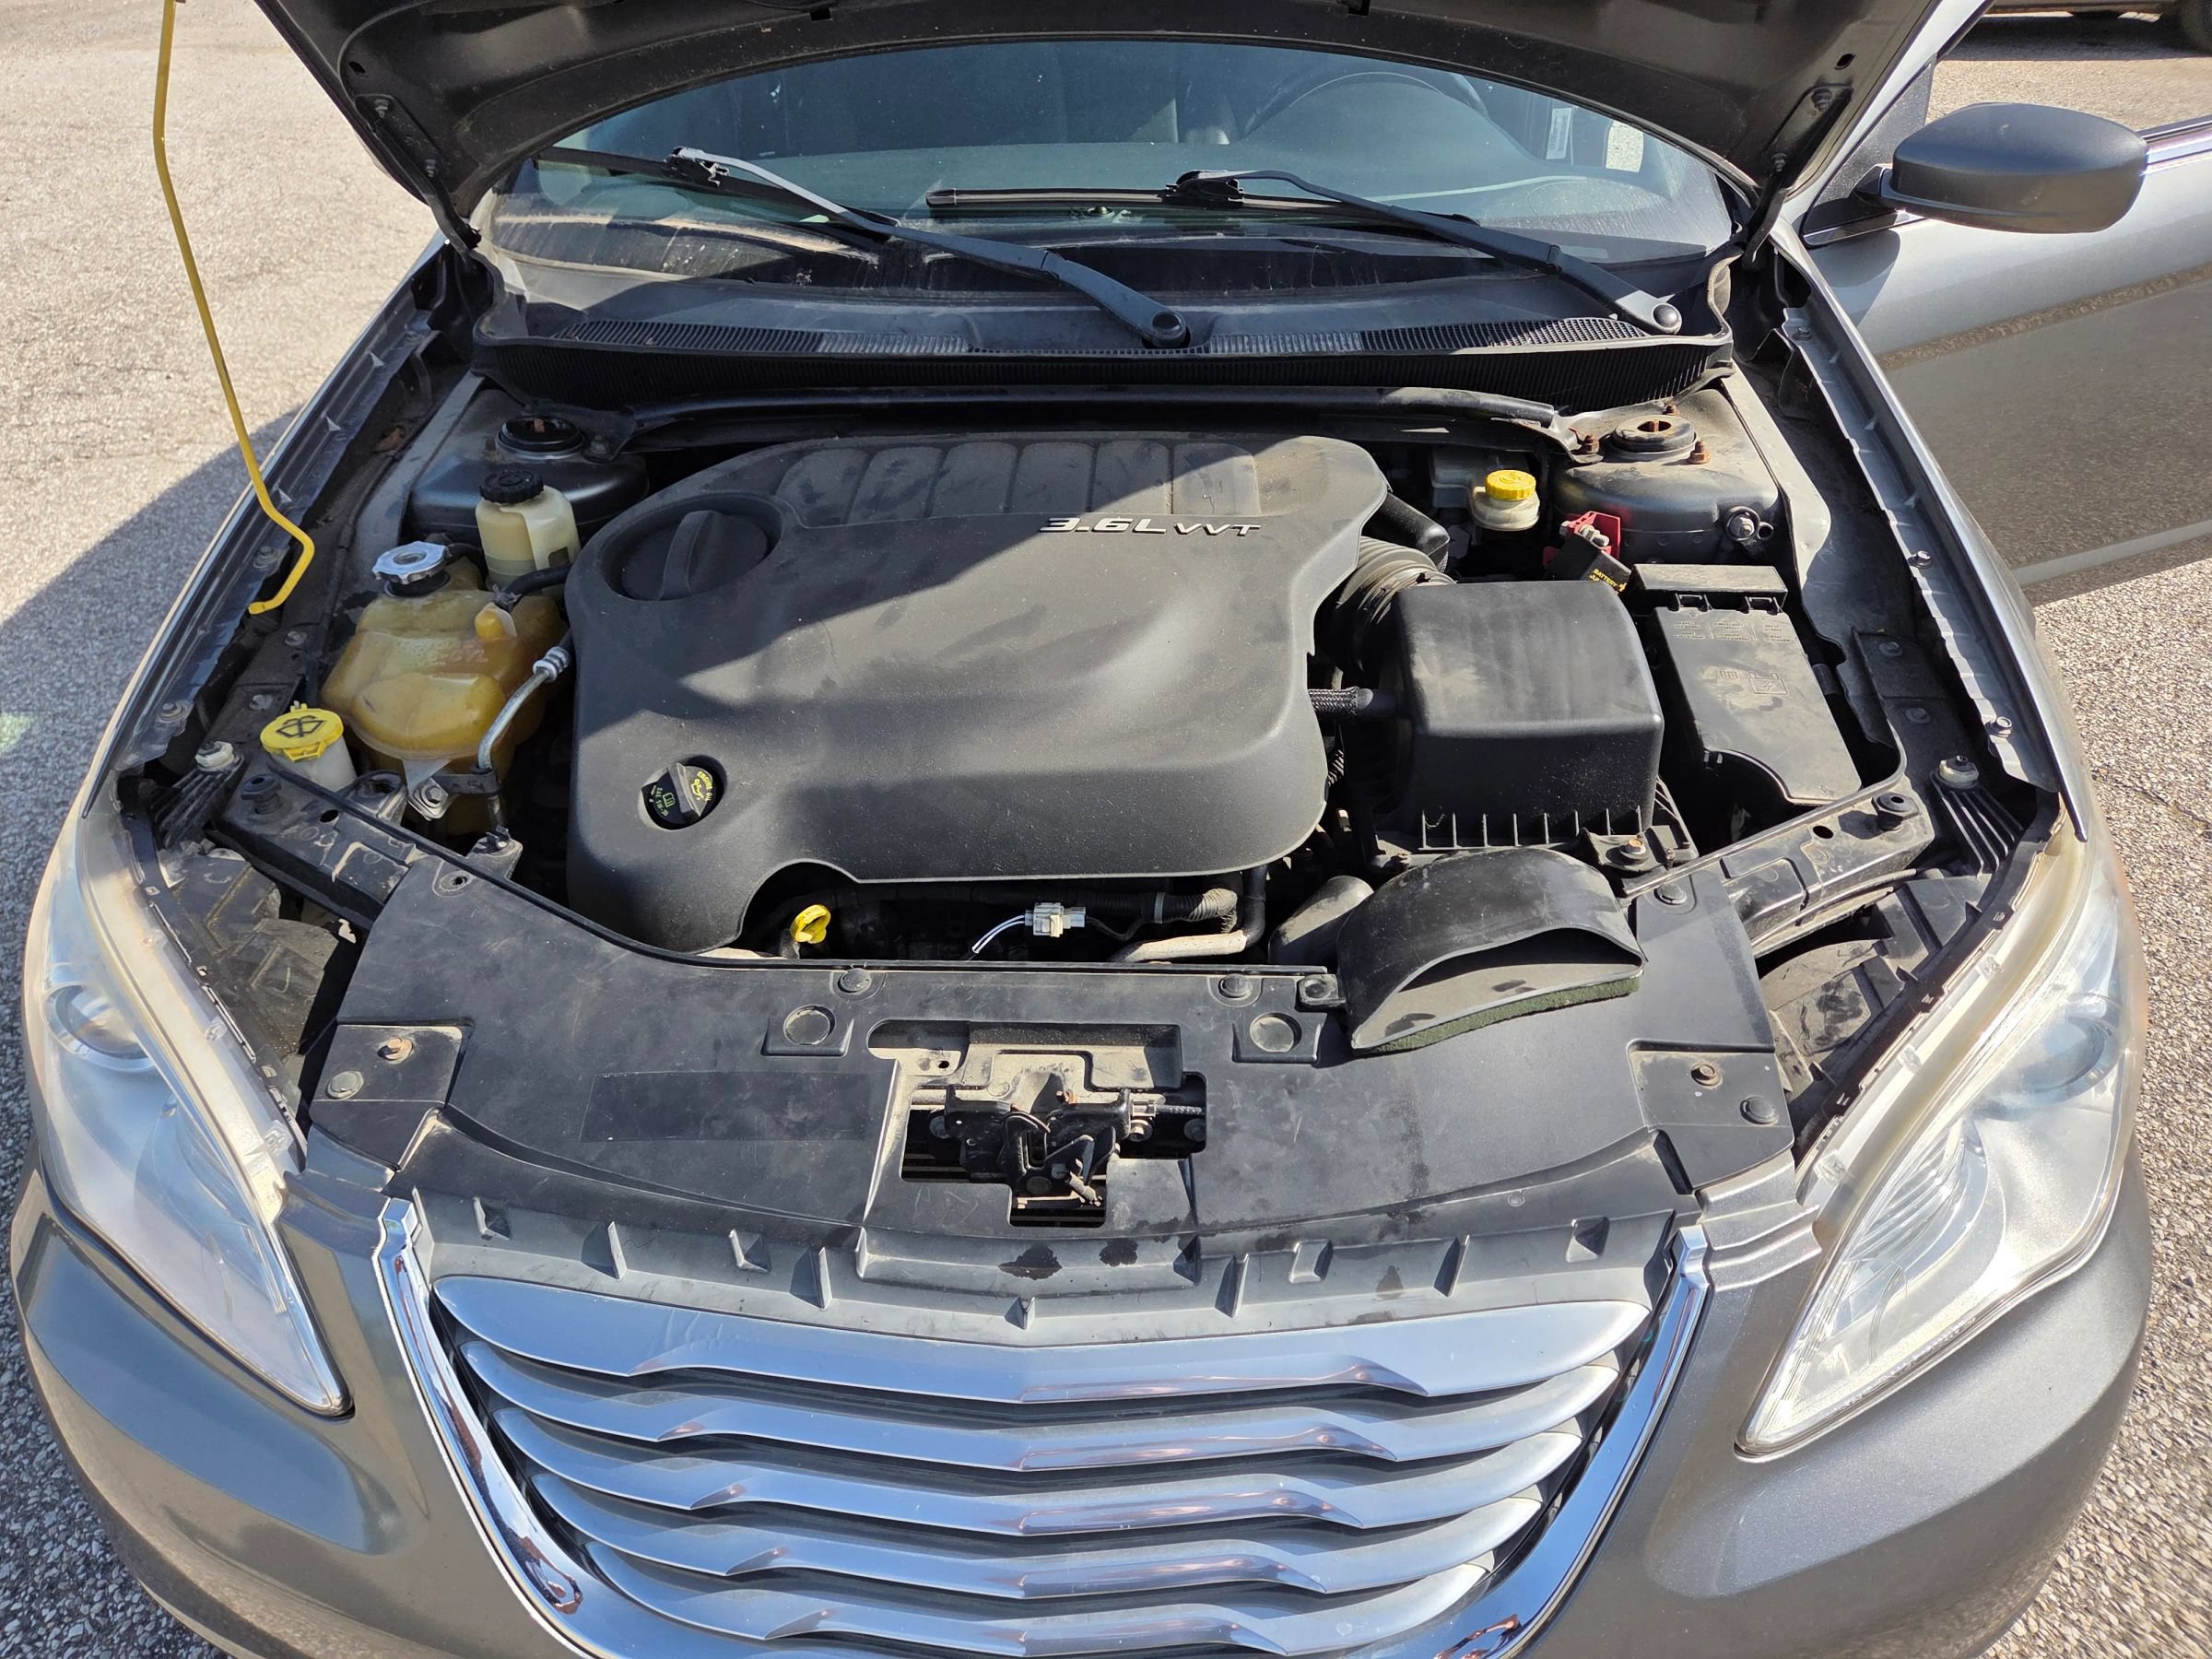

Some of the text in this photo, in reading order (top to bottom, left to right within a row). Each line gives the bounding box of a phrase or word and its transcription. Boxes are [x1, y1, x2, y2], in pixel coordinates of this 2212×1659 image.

[1039, 517, 1262, 536] 3.6L VVT
[1593, 568, 1618, 587] BATTERY
[697, 771, 712, 802] ENGINE OIL
